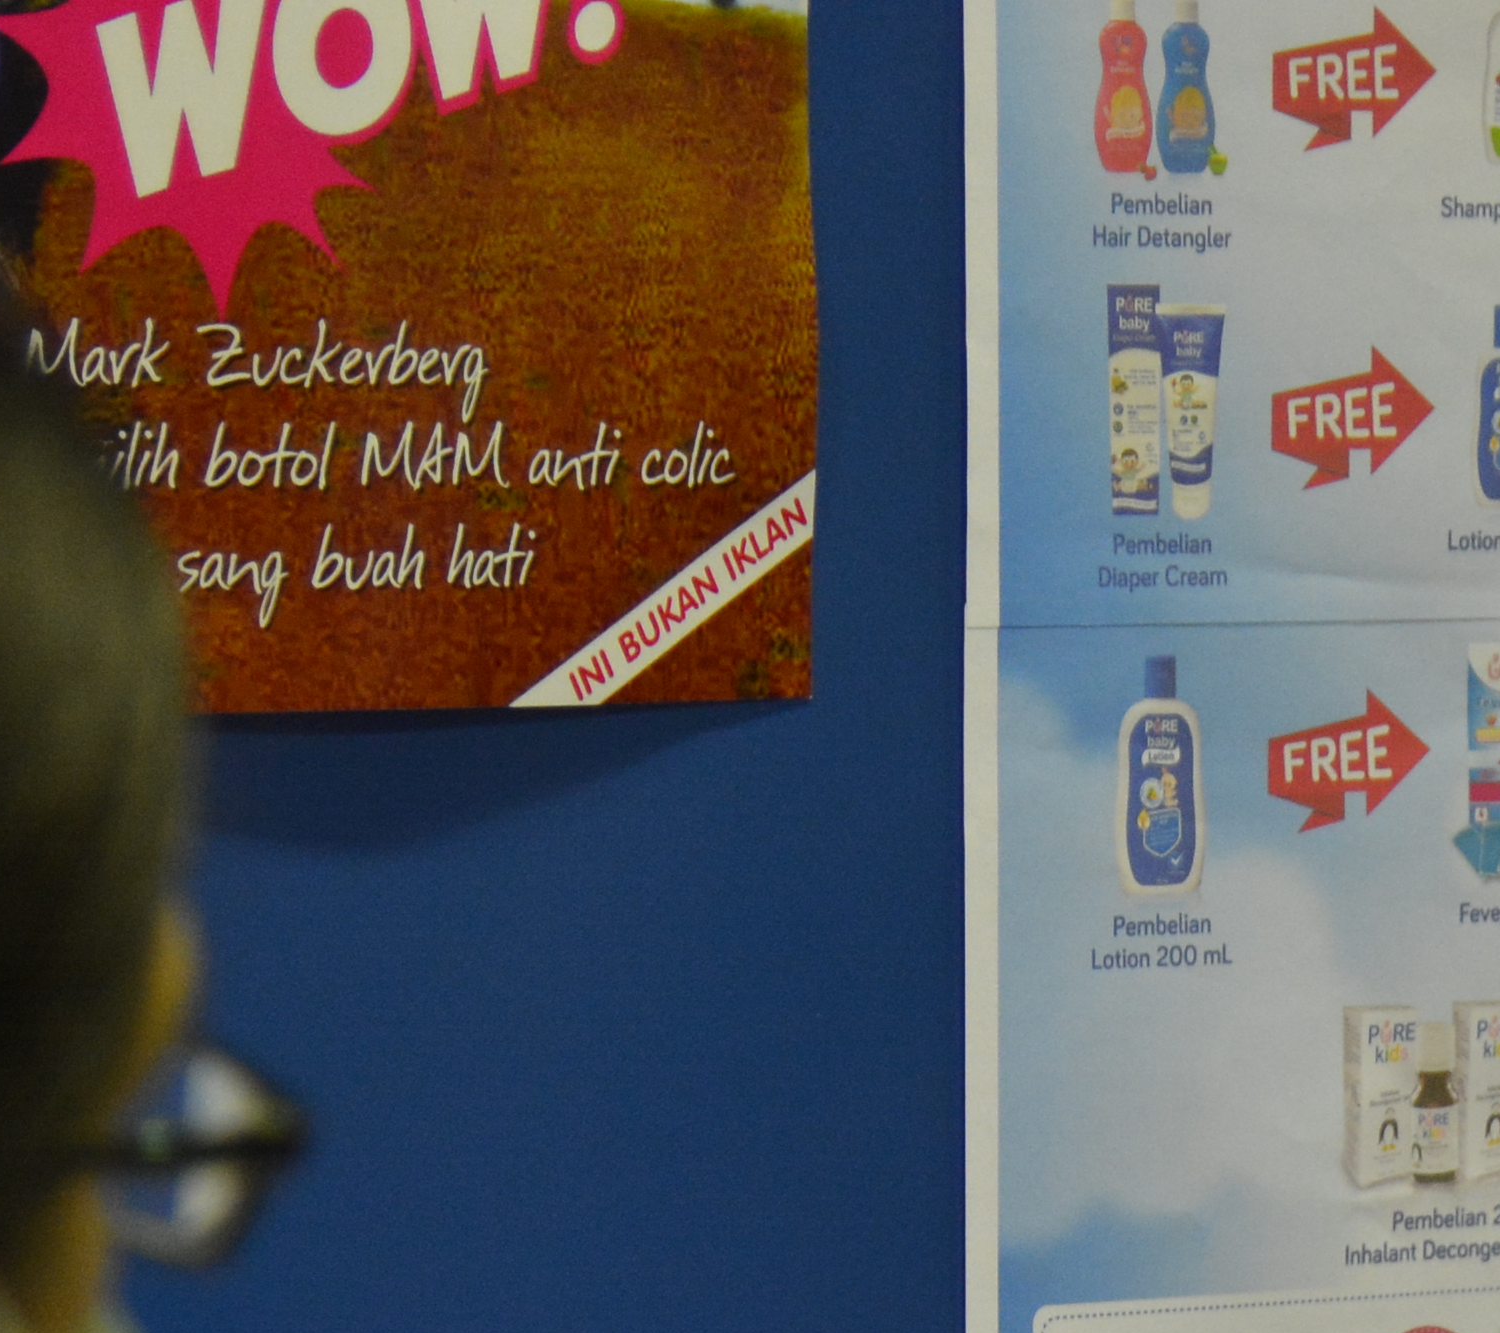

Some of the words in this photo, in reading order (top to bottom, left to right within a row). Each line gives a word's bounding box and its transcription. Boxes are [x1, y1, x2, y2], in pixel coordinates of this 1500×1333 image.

[1287, 43, 1400, 98] FREE
[96, 0, 618, 198] WOW
[1111, 192, 1213, 218] Pembelian
[1092, 226, 1131, 250] Hair
[1137, 226, 1232, 254] Detangler
[1119, 315, 1151, 333] baby
[24, 317, 169, 389] Mark
[197, 319, 488, 421] Zuckerberg
[1286, 381, 1398, 440] FREE
[205, 422, 336, 489] botol
[360, 421, 511, 490] MAM
[529, 422, 621, 490] anti
[641, 422, 735, 488] colic
[1112, 533, 1213, 556] Pembelian
[178, 546, 288, 628] sang
[313, 523, 424, 590] buah
[448, 523, 536, 587] hati
[1098, 566, 1160, 592] Diaper
[1164, 564, 1228, 588] Cream
[569, 649, 615, 701] INI
[619, 574, 720, 664] BUKAN
[722, 497, 809, 581] IKLAN
[1282, 724, 1393, 784] FREE
[1112, 914, 1212, 939] Pembelian
[1091, 947, 1151, 971] Lotion
[1156, 945, 1198, 969] 200
[1202, 944, 1233, 967] mL
[1368, 1019, 1417, 1045] PURE
[1374, 1044, 1410, 1064] kids
[1392, 1207, 1488, 1232] Pembelian
[1344, 1241, 1418, 1266] Inhalant
